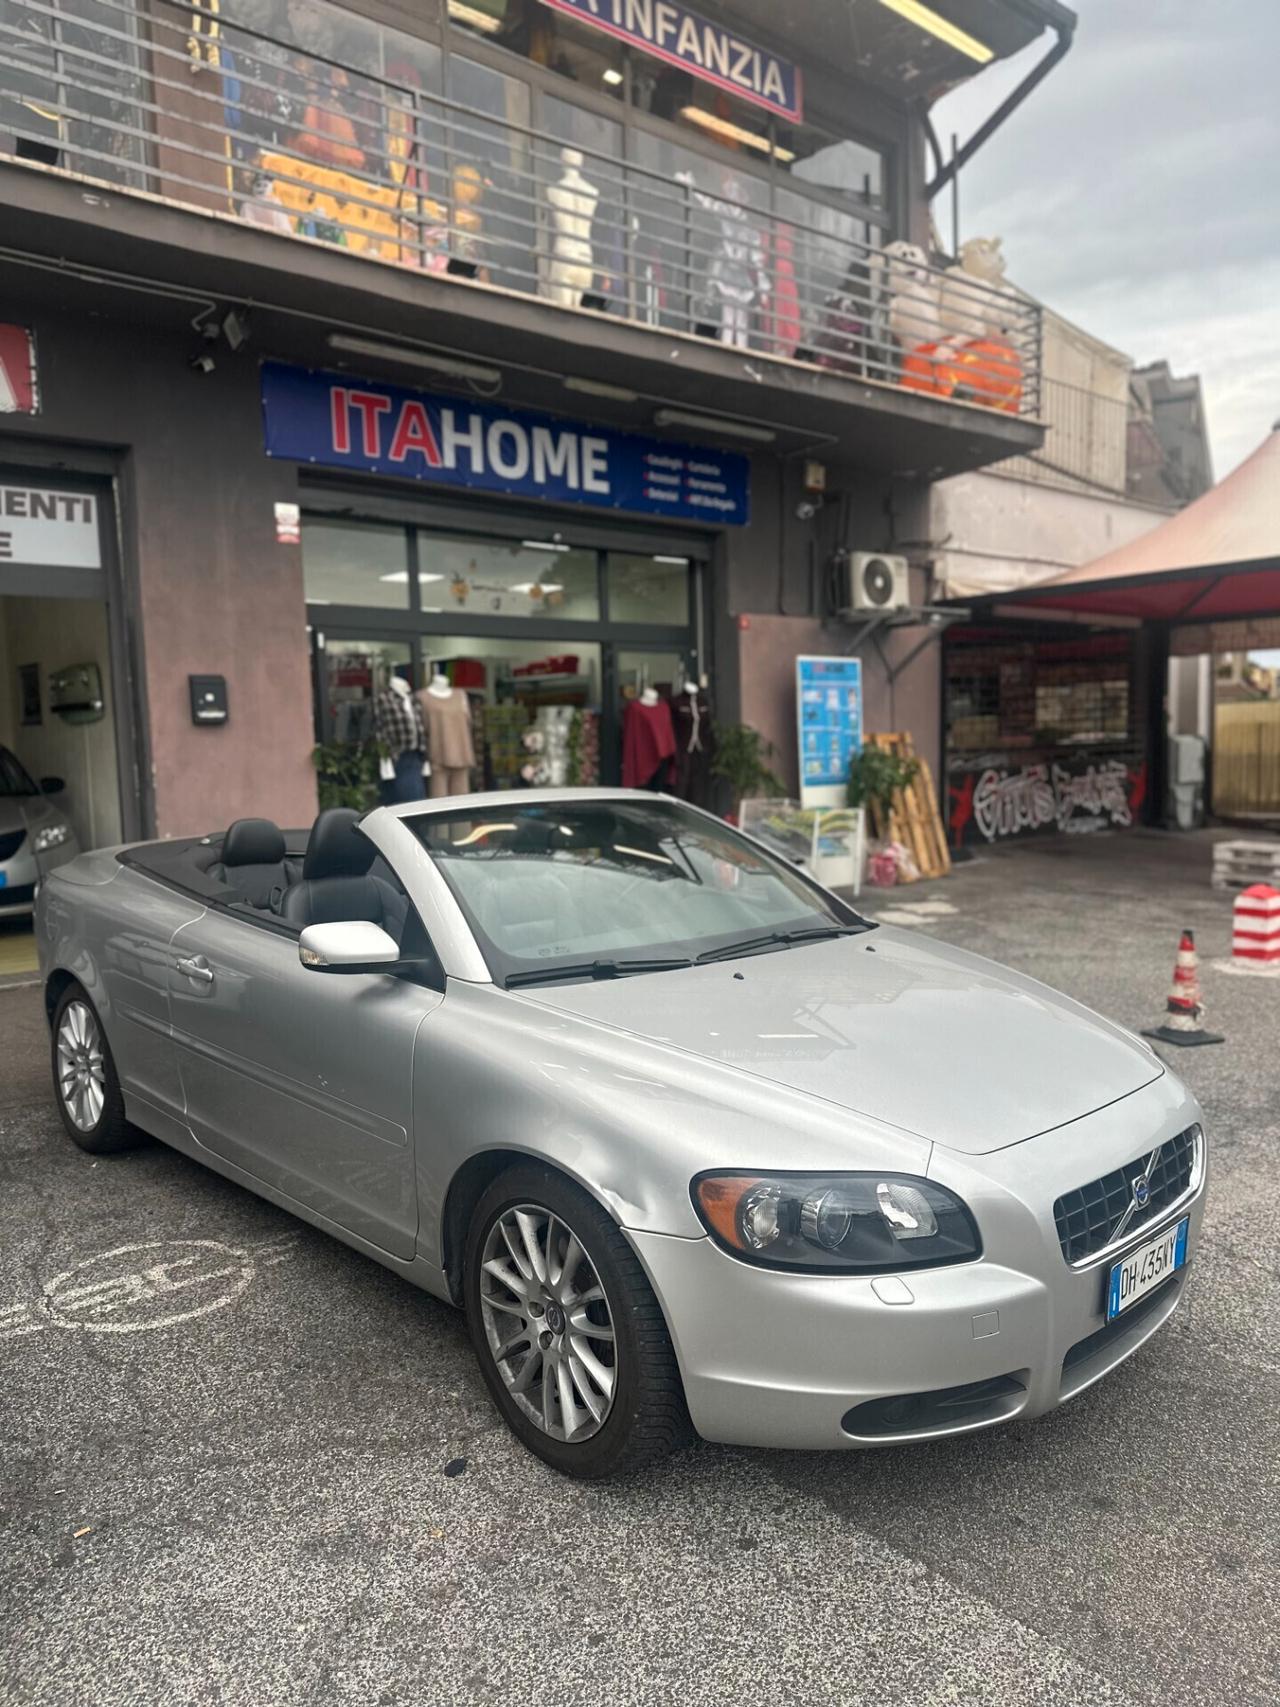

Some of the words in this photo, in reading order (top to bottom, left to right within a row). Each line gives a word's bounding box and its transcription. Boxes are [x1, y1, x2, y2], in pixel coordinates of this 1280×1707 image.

[612, 0, 786, 104] INFANZIA
[330, 386, 610, 494] ITAHOME
[0, 488, 92, 524] ENTI
